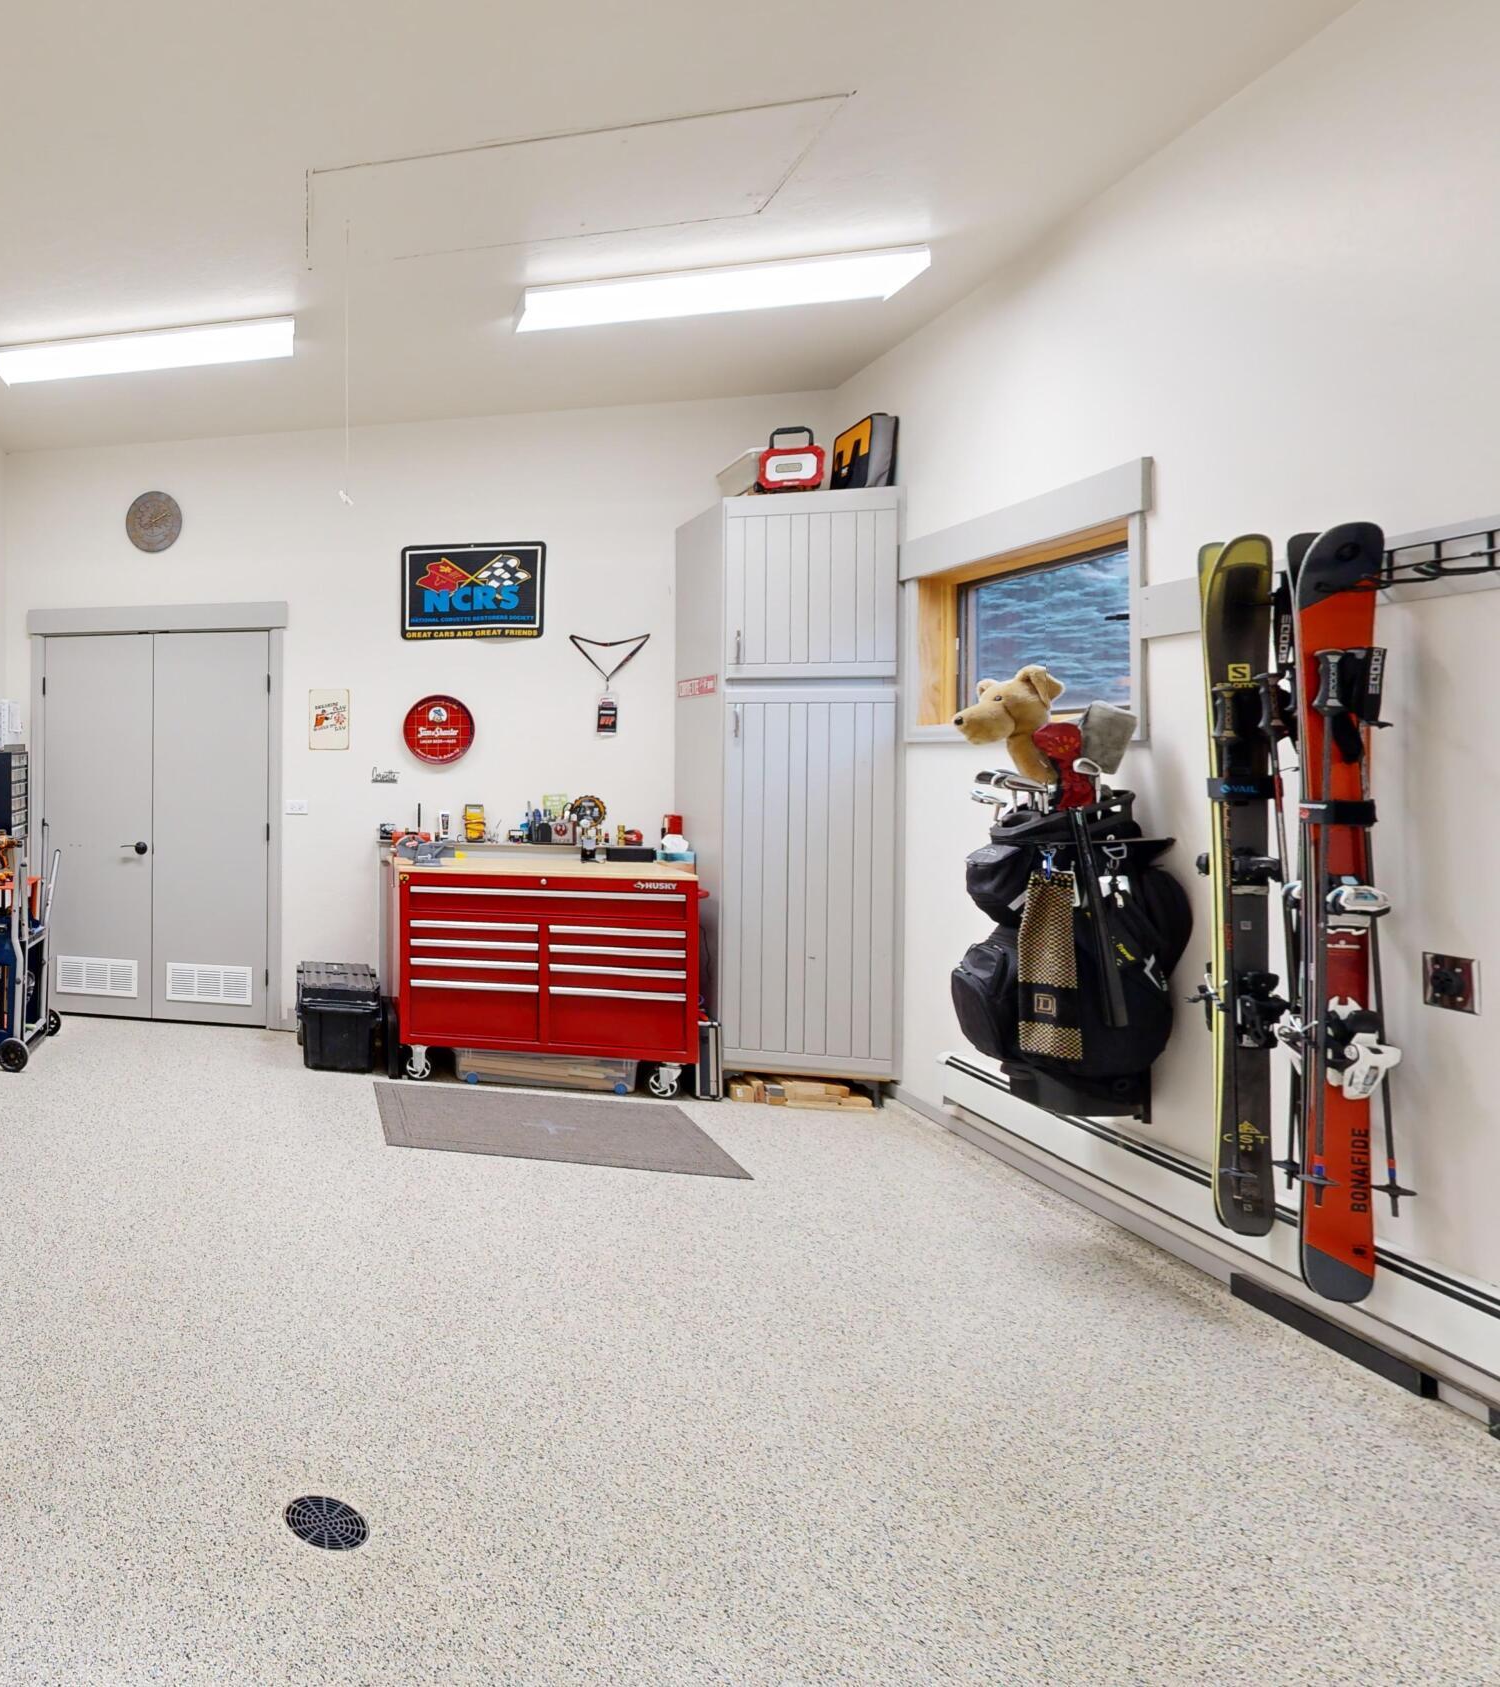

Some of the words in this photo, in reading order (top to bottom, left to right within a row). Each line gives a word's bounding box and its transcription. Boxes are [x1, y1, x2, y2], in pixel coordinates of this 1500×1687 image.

[423, 584, 520, 613] NCRS
[645, 882, 677, 890] HUSKY
[1350, 1127, 1370, 1213] BONAFIDE
